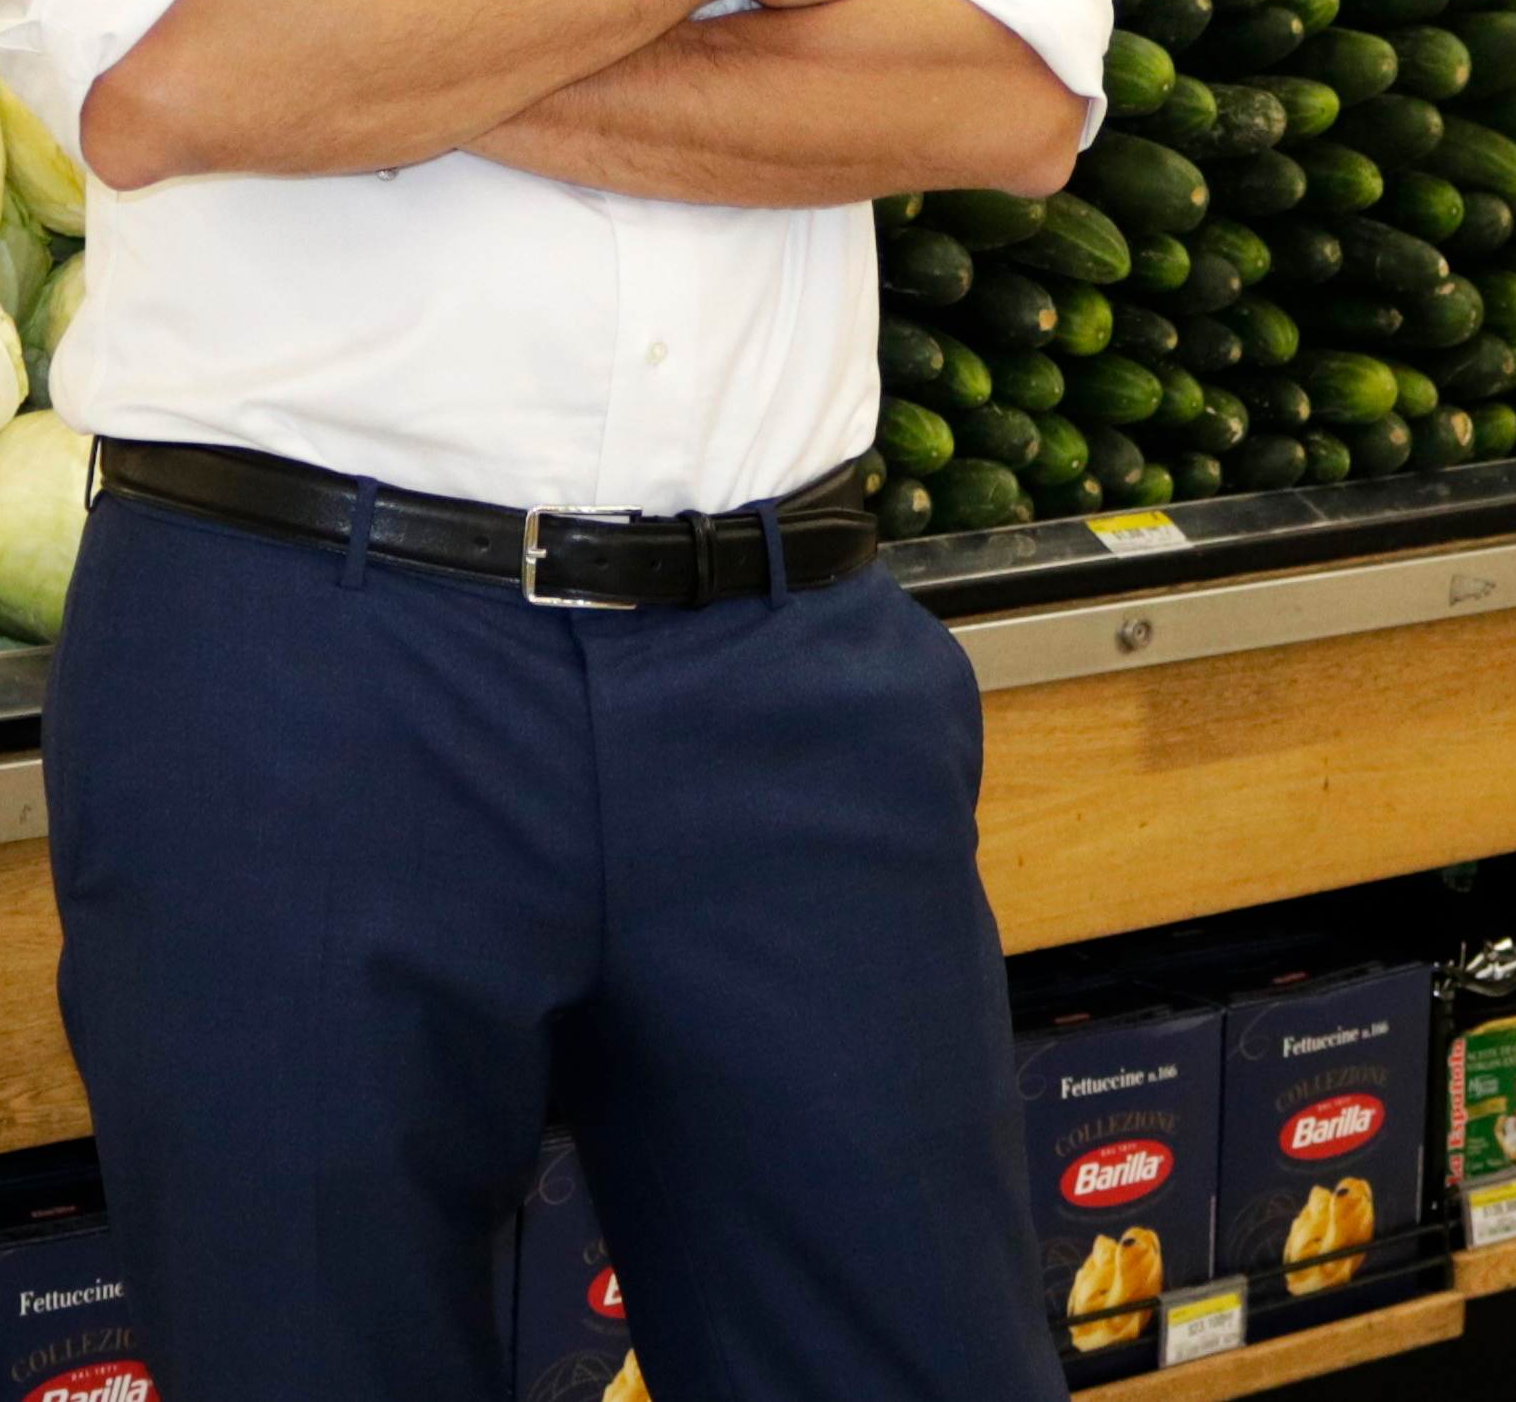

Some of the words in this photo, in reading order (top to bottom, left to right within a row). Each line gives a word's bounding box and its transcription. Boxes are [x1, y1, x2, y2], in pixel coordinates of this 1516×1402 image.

[1283, 1025, 1360, 1058] Fettuccine
[1060, 1066, 1145, 1100] Fettuccine
[1291, 1104, 1375, 1150] Barilla
[1073, 1150, 1161, 1196] Barilla
[19, 1278, 125, 1316] Fettuccine
